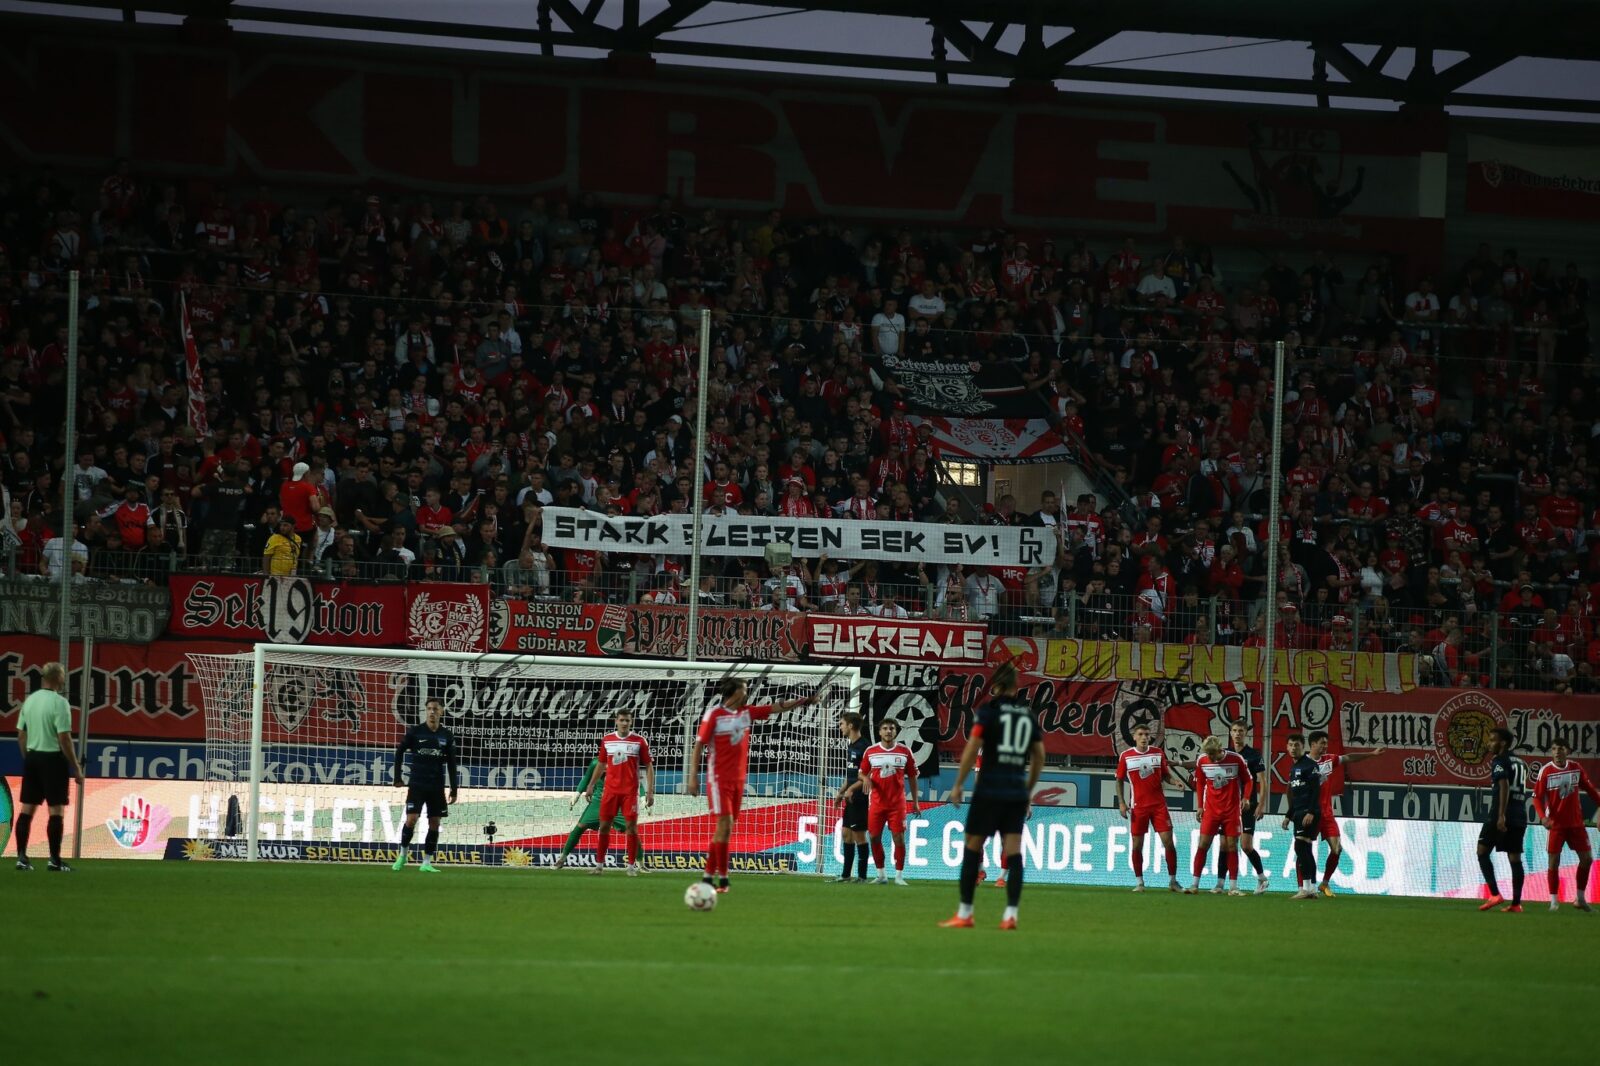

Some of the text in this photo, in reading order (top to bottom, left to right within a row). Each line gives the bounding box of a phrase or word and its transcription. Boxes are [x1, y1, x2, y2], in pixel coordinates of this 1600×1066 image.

[555, 516, 669, 544] STARK
[860, 529, 926, 553] SEK
[1454, 529, 1472, 544] HFC
[1002, 569, 1024, 582] HFC
[424, 603, 443, 612] HFC
[449, 611, 470, 621] RWE
[455, 603, 467, 614] FC
[527, 602, 582, 616] SEKTION
[514, 614, 595, 631] MANSFELD
[517, 632, 586, 653] SÜDHARZ
[813, 622, 984, 660] SURREALE
[1044, 638, 1227, 684] BULLEN
[887, 664, 939, 687] HFC
[1439, 694, 1505, 726] HALLESCHER
[997, 713, 1033, 755] 10
[1341, 701, 1434, 748] Leuna
[484, 739, 508, 750] Heino
[1403, 754, 1437, 777] seit
[797, 815, 818, 864] 5
[731, 857, 789, 872] HALLE
